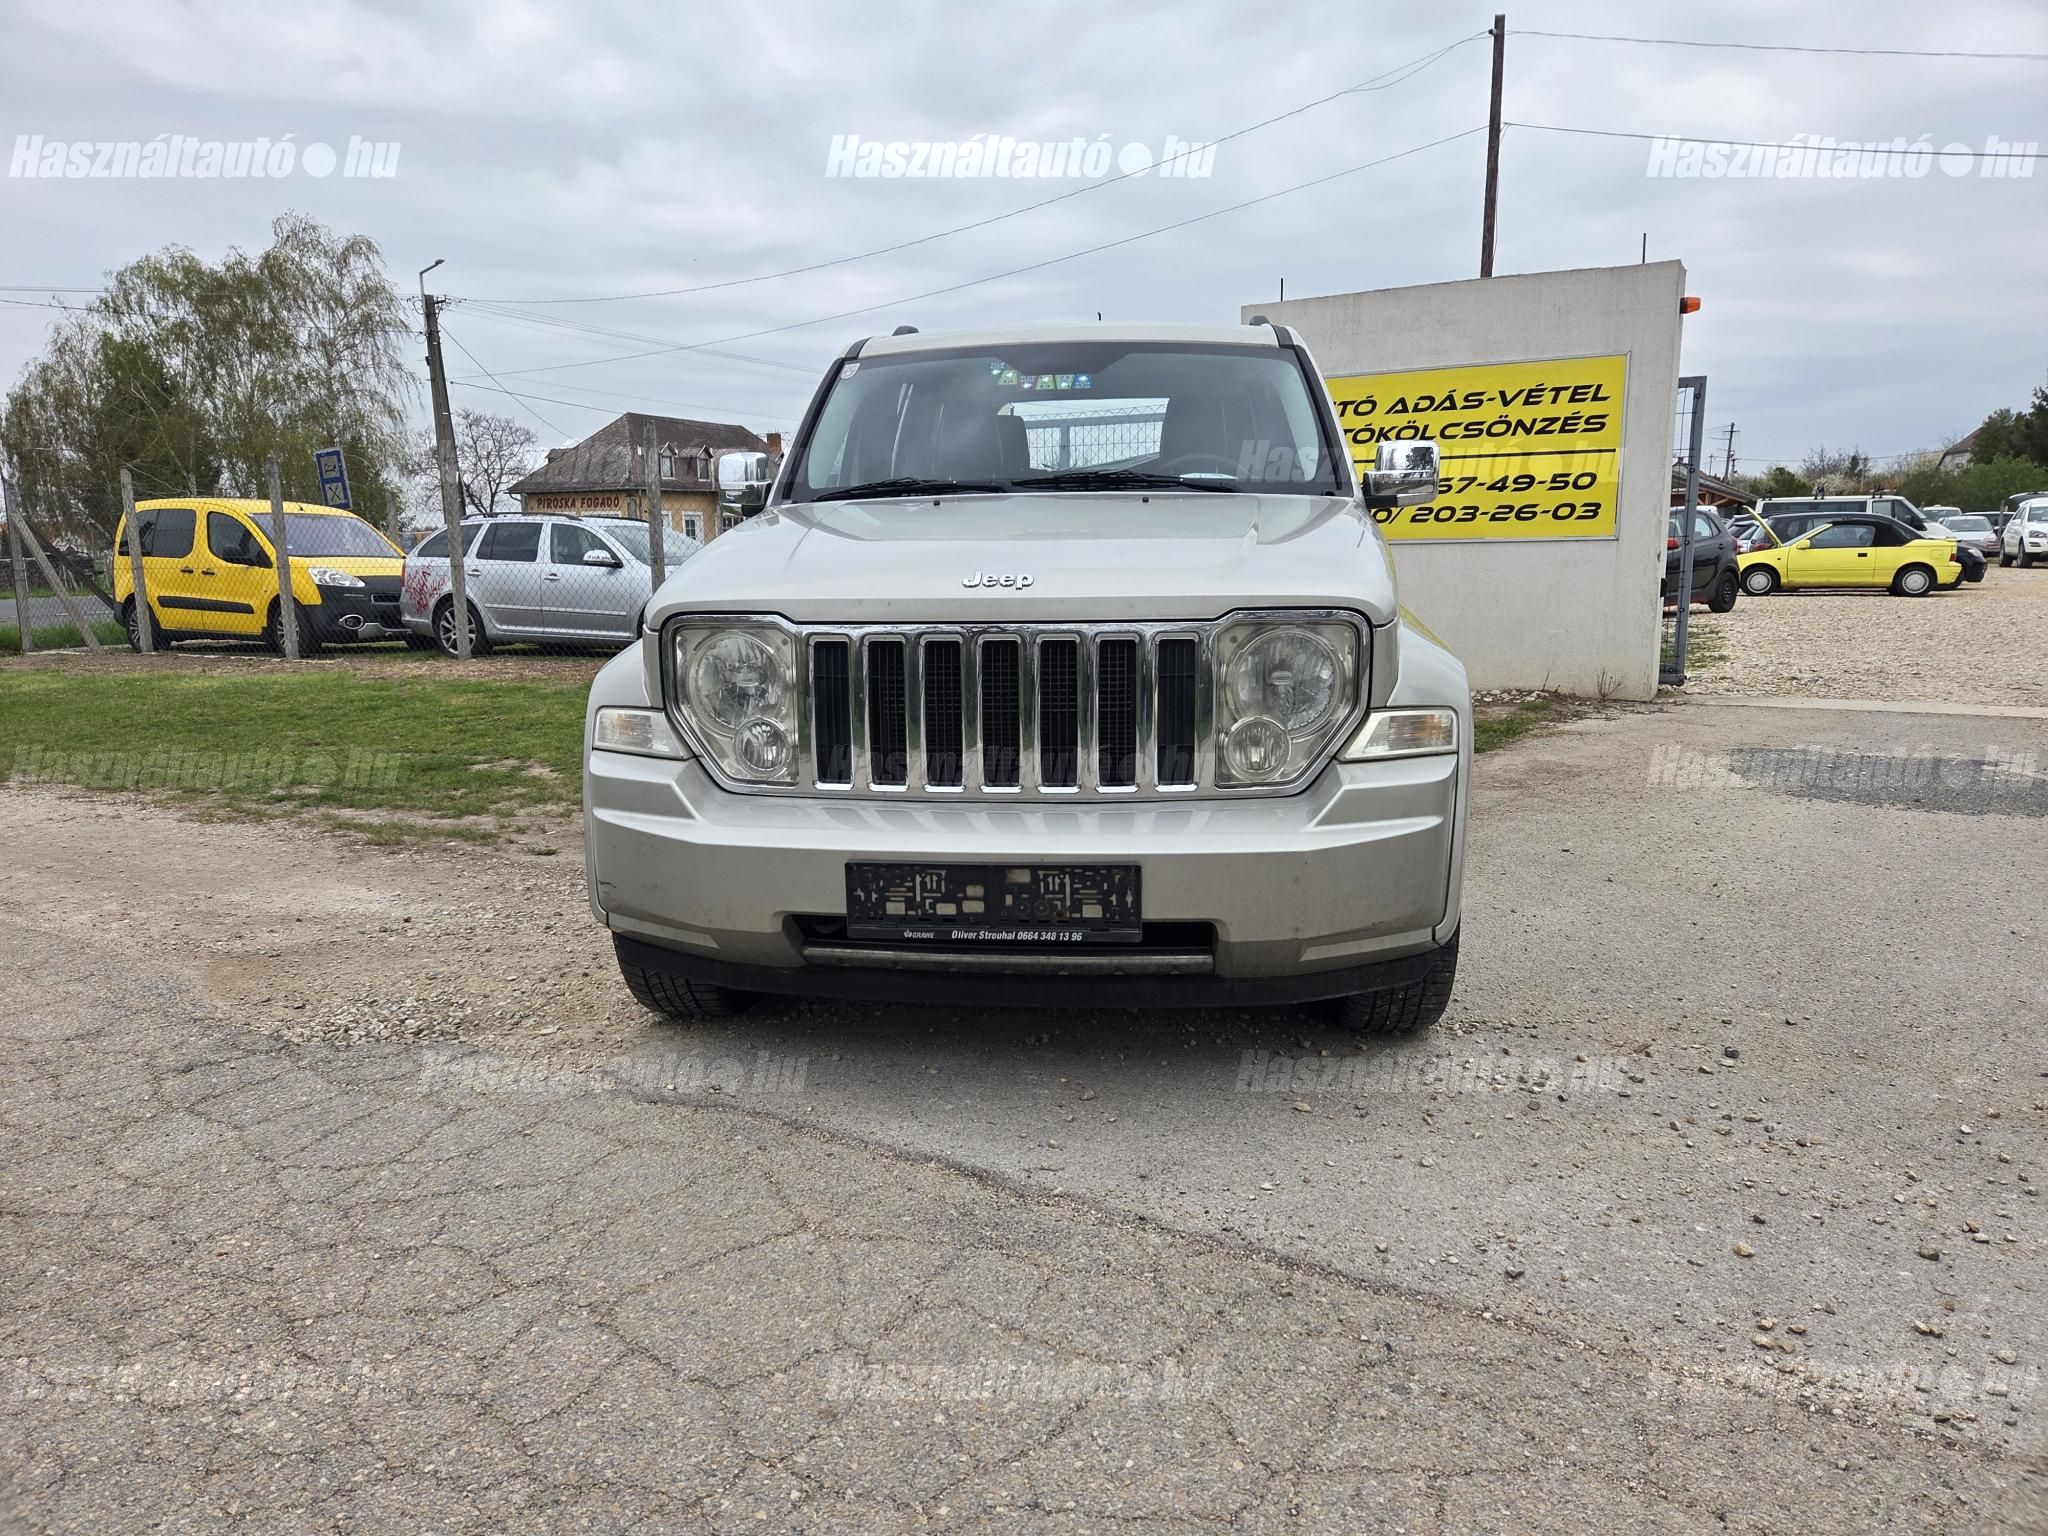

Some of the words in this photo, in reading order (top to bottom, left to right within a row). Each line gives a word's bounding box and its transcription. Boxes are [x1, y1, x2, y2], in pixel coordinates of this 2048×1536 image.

[1333, 394, 1378, 418] TÓ
[1384, 383, 1611, 416] ADÁS-VÉTEL
[537, 497, 576, 509] PIROSKA
[580, 495, 620, 509] FOGADÓ
[1409, 501, 1602, 524] 203-26-03
[962, 571, 1034, 591] Jeep
[951, 930, 977, 939] Oliver
[978, 930, 1015, 940] Strouhal
[1017, 931, 1039, 940] 0664
[1040, 931, 1057, 940] 348
[1058, 932, 1069, 941] 13
